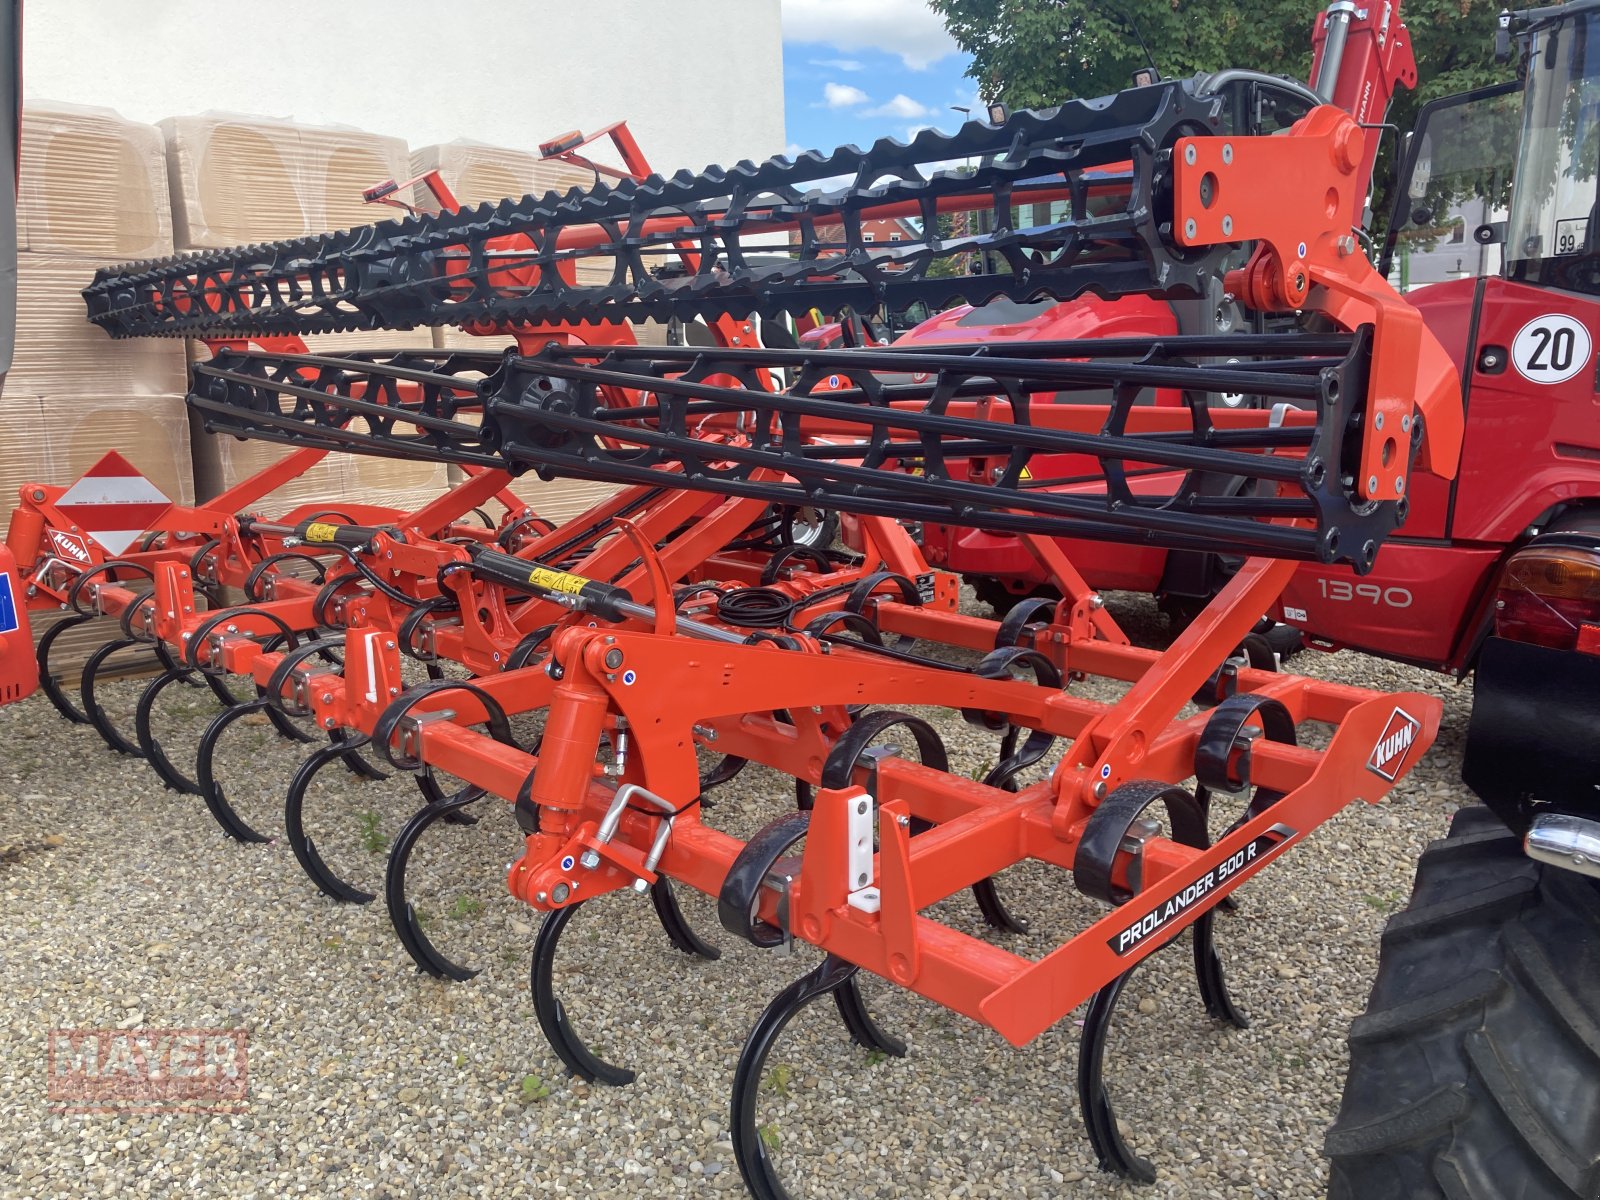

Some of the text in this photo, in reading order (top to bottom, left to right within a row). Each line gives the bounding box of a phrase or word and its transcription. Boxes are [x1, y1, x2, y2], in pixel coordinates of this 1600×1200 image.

[1560, 235, 1575, 252] 99
[1527, 327, 1575, 371] 20
[54, 533, 88, 561] KUHN
[1318, 578, 1413, 608] 1390
[1376, 722, 1413, 769] KUHN
[1119, 841, 1257, 951] PROLANDER 500 R
